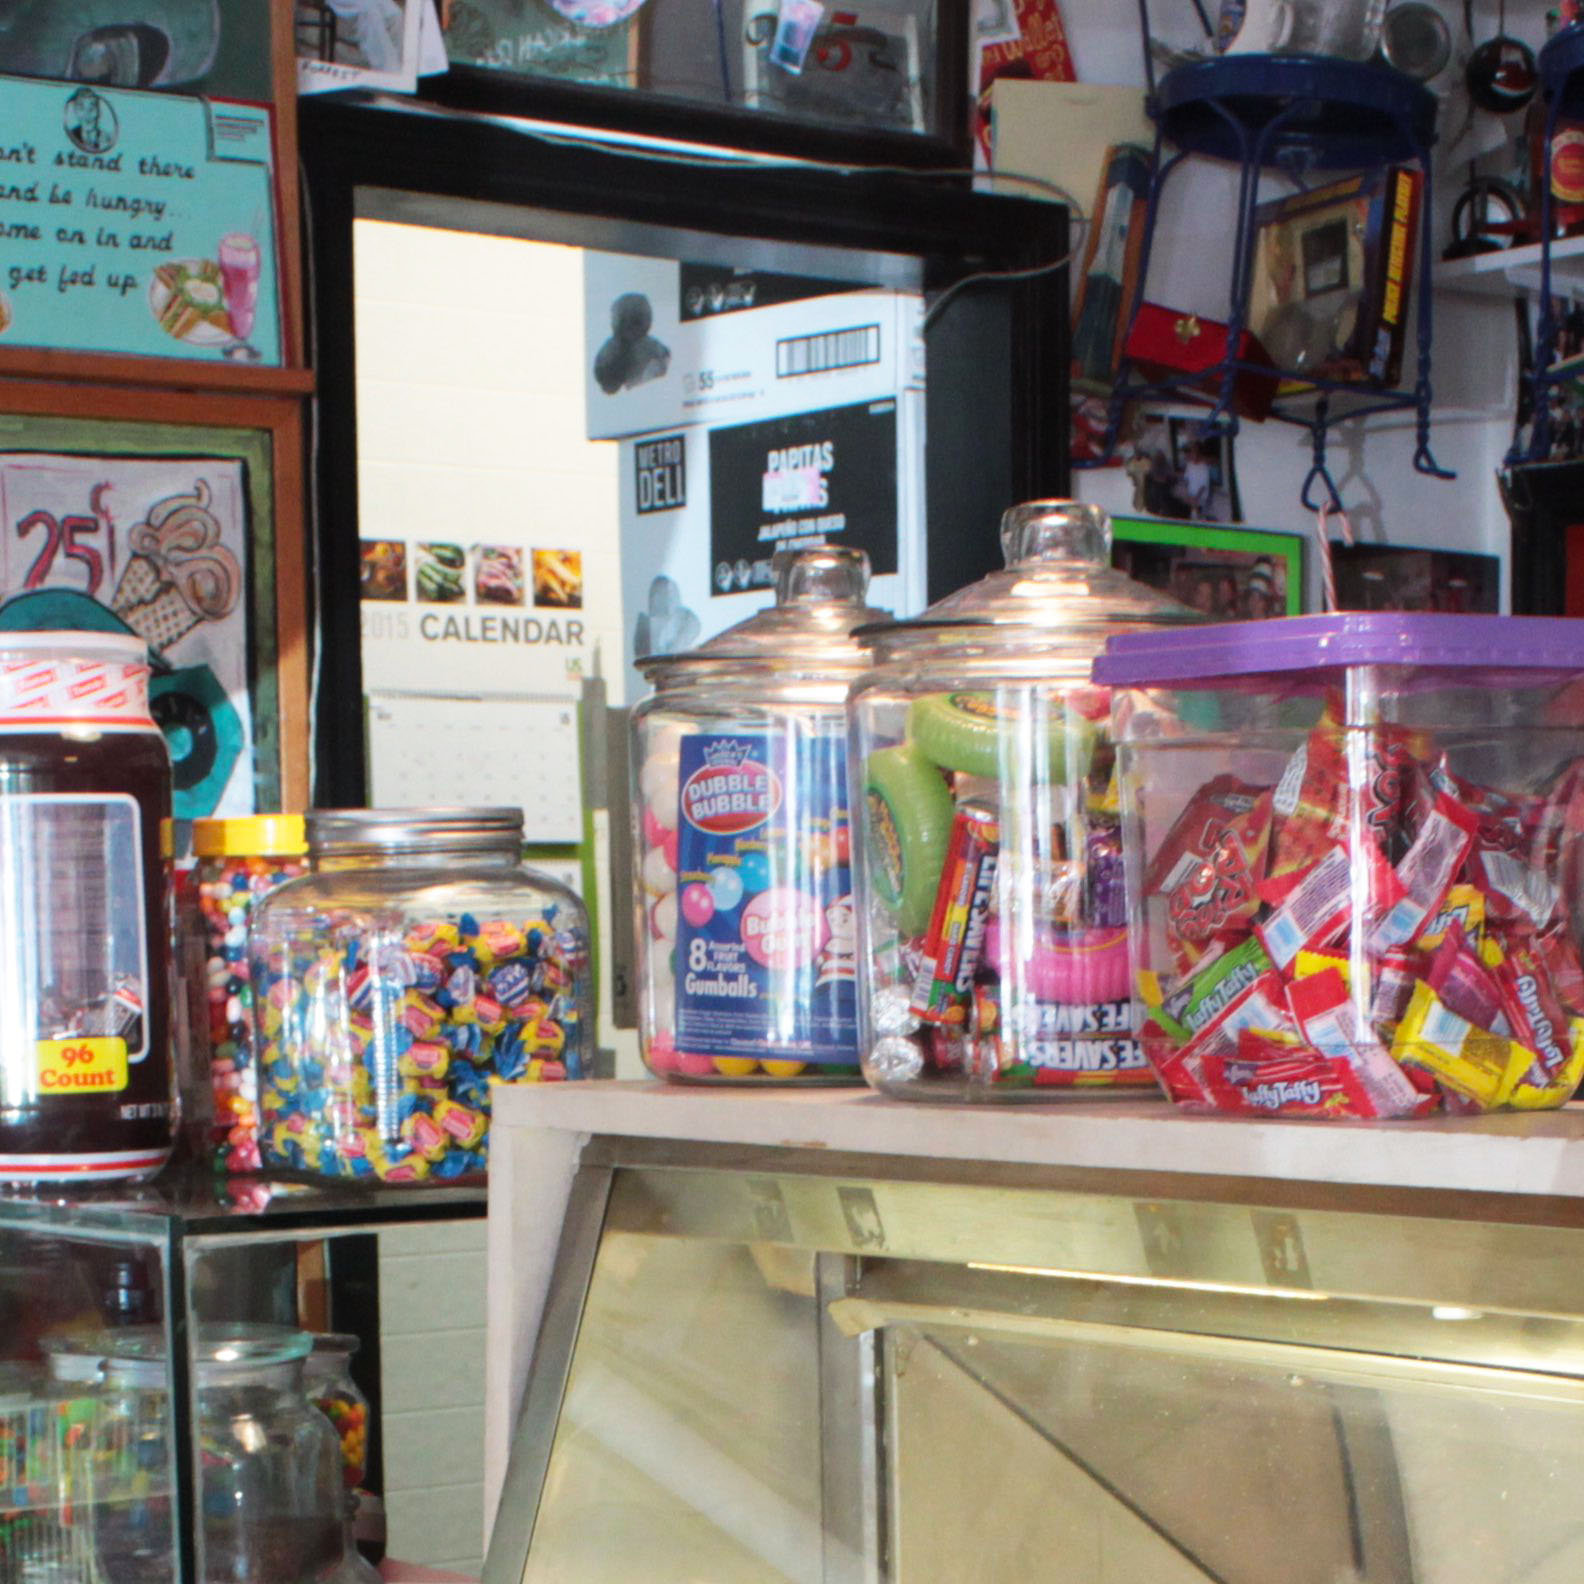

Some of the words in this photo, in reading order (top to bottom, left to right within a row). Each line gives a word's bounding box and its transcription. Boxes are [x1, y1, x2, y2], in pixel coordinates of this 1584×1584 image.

[53, 147, 121, 173] stand
[138, 156, 196, 180] there
[48, 181, 73, 205] be
[56, 229, 87, 247] on
[96, 226, 120, 249] in
[129, 231, 174, 253] and
[8, 265, 48, 293] get
[58, 265, 96, 294] fed
[106, 273, 140, 295] up
[767, 442, 834, 474] PAPITAS
[639, 466, 684, 508] DELI
[419, 612, 585, 647] CALENDAR
[688, 773, 769, 801] DUBBLE
[690, 793, 770, 821] BUBBLE
[688, 938, 708, 972] 8
[684, 972, 758, 998] Gumballs
[59, 1045, 95, 1067] 96
[39, 1065, 116, 1090] Count
